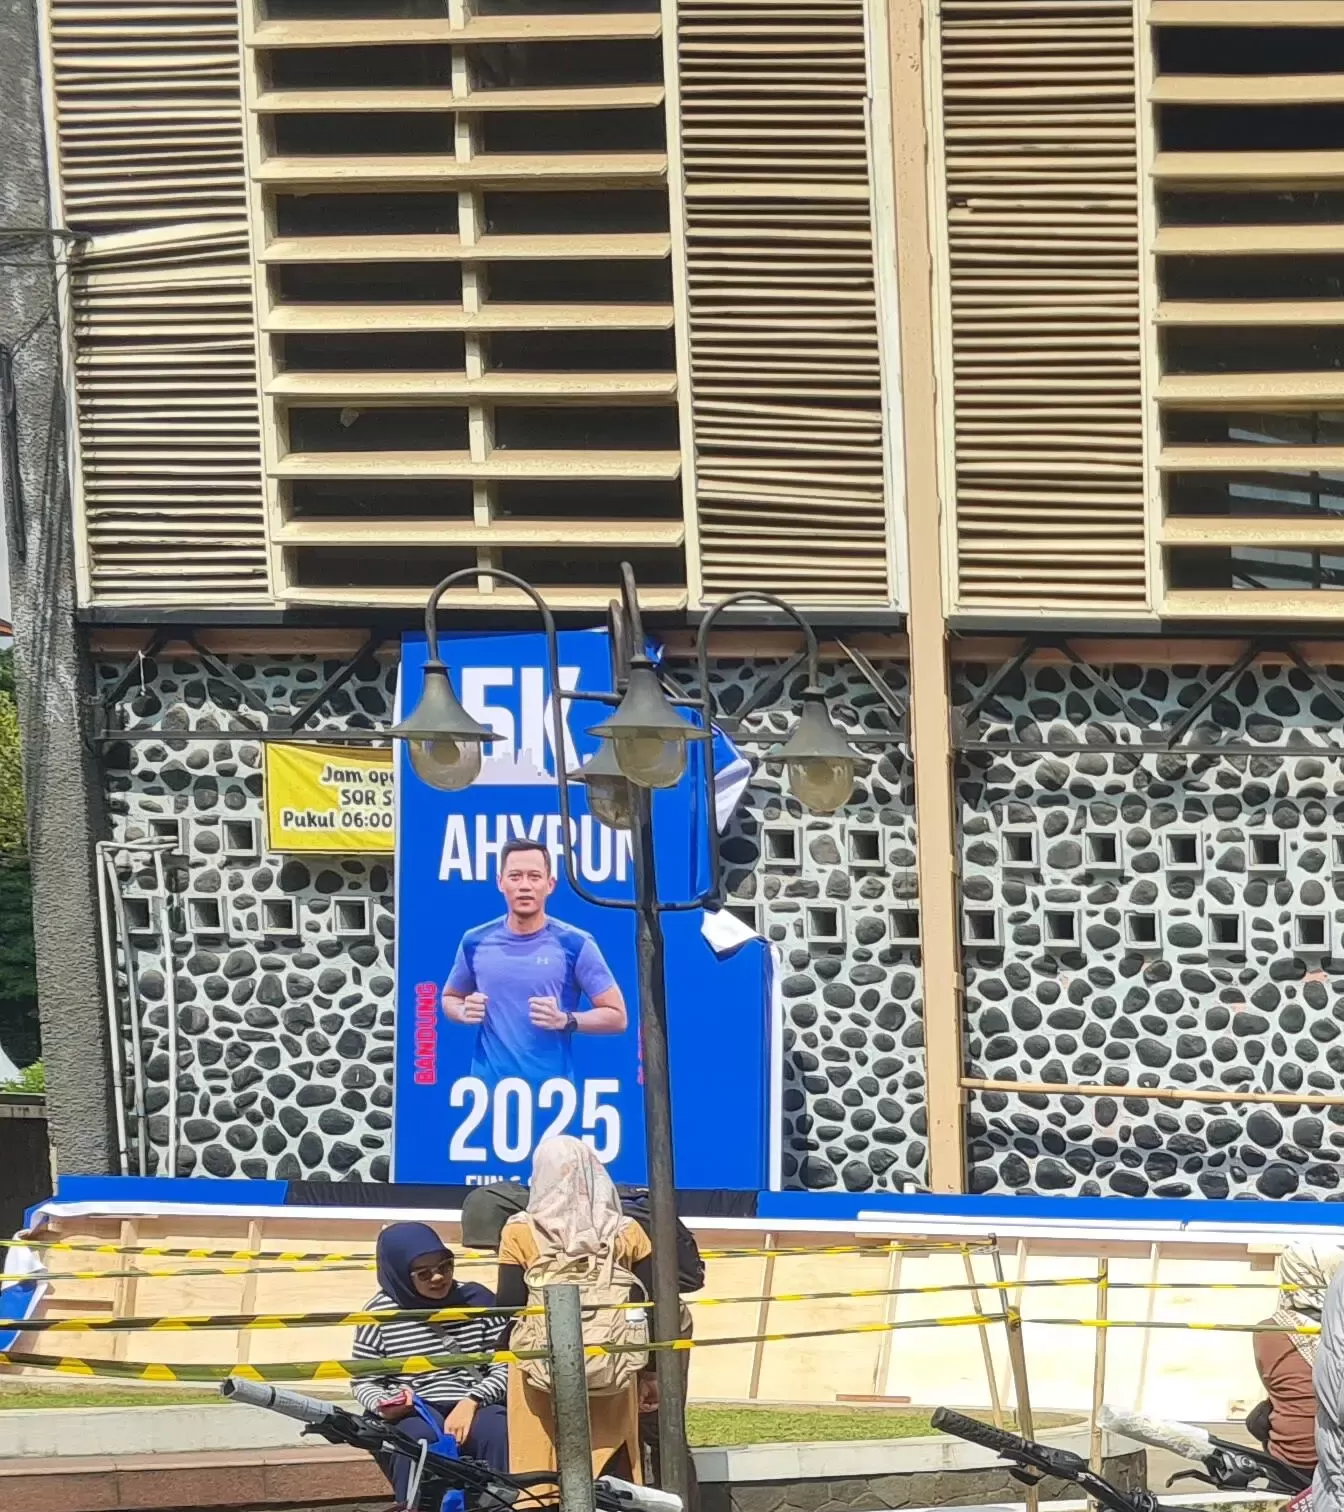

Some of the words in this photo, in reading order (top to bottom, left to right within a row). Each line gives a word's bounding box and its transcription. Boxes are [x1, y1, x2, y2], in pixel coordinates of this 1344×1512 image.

[322, 766, 363, 783] Jam
[341, 789, 376, 805] SOR
[283, 811, 334, 828] Pukul
[414, 980, 438, 1085] BANDUNG
[449, 1076, 621, 1164] 2025
